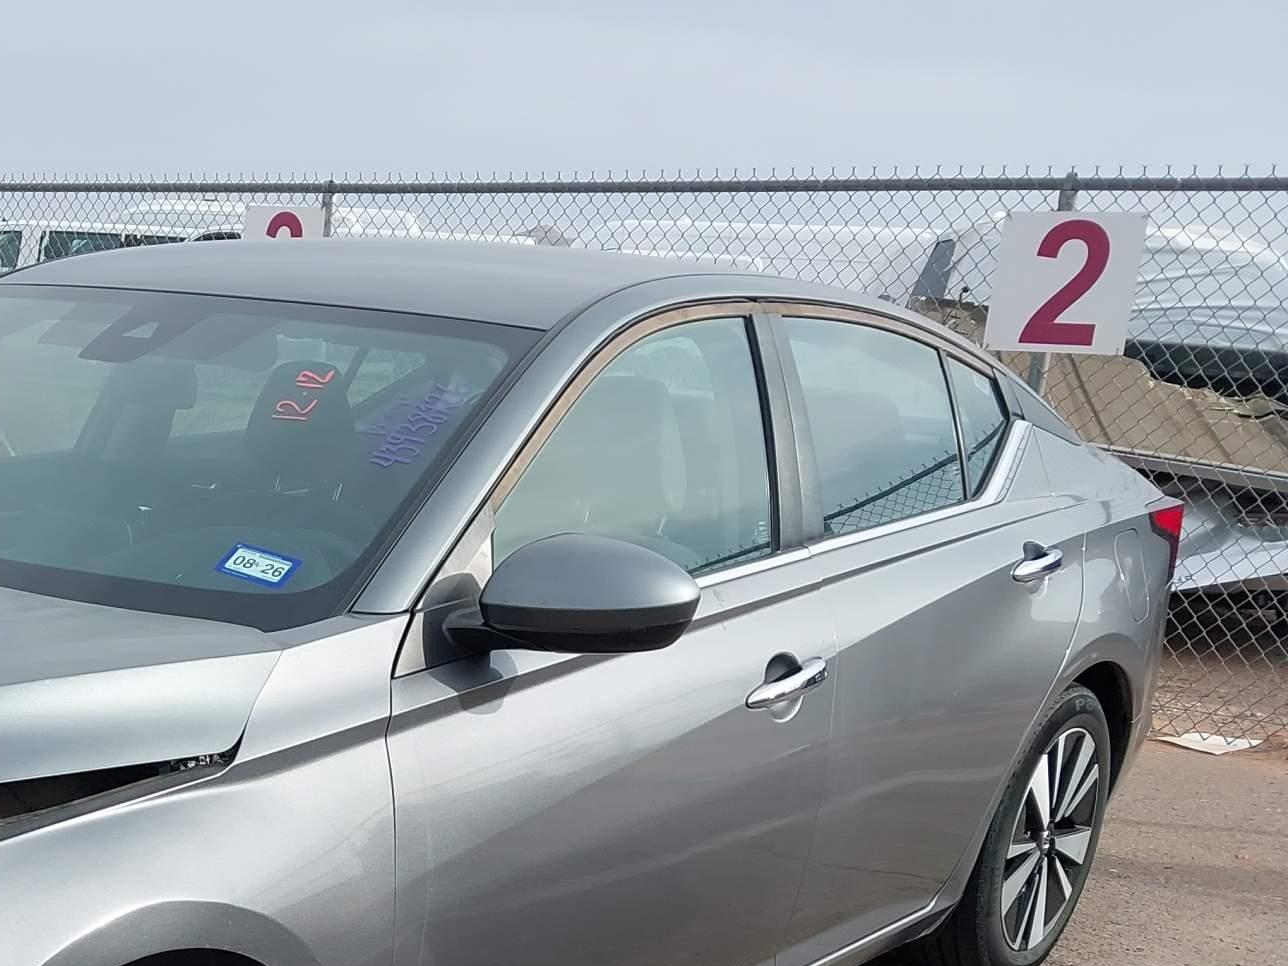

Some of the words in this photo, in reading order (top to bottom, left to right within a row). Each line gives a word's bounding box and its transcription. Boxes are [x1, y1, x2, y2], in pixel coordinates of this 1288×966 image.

[1018, 219, 1111, 346] 2
[233, 555, 256, 569] 08
[260, 563, 285, 577] 26
